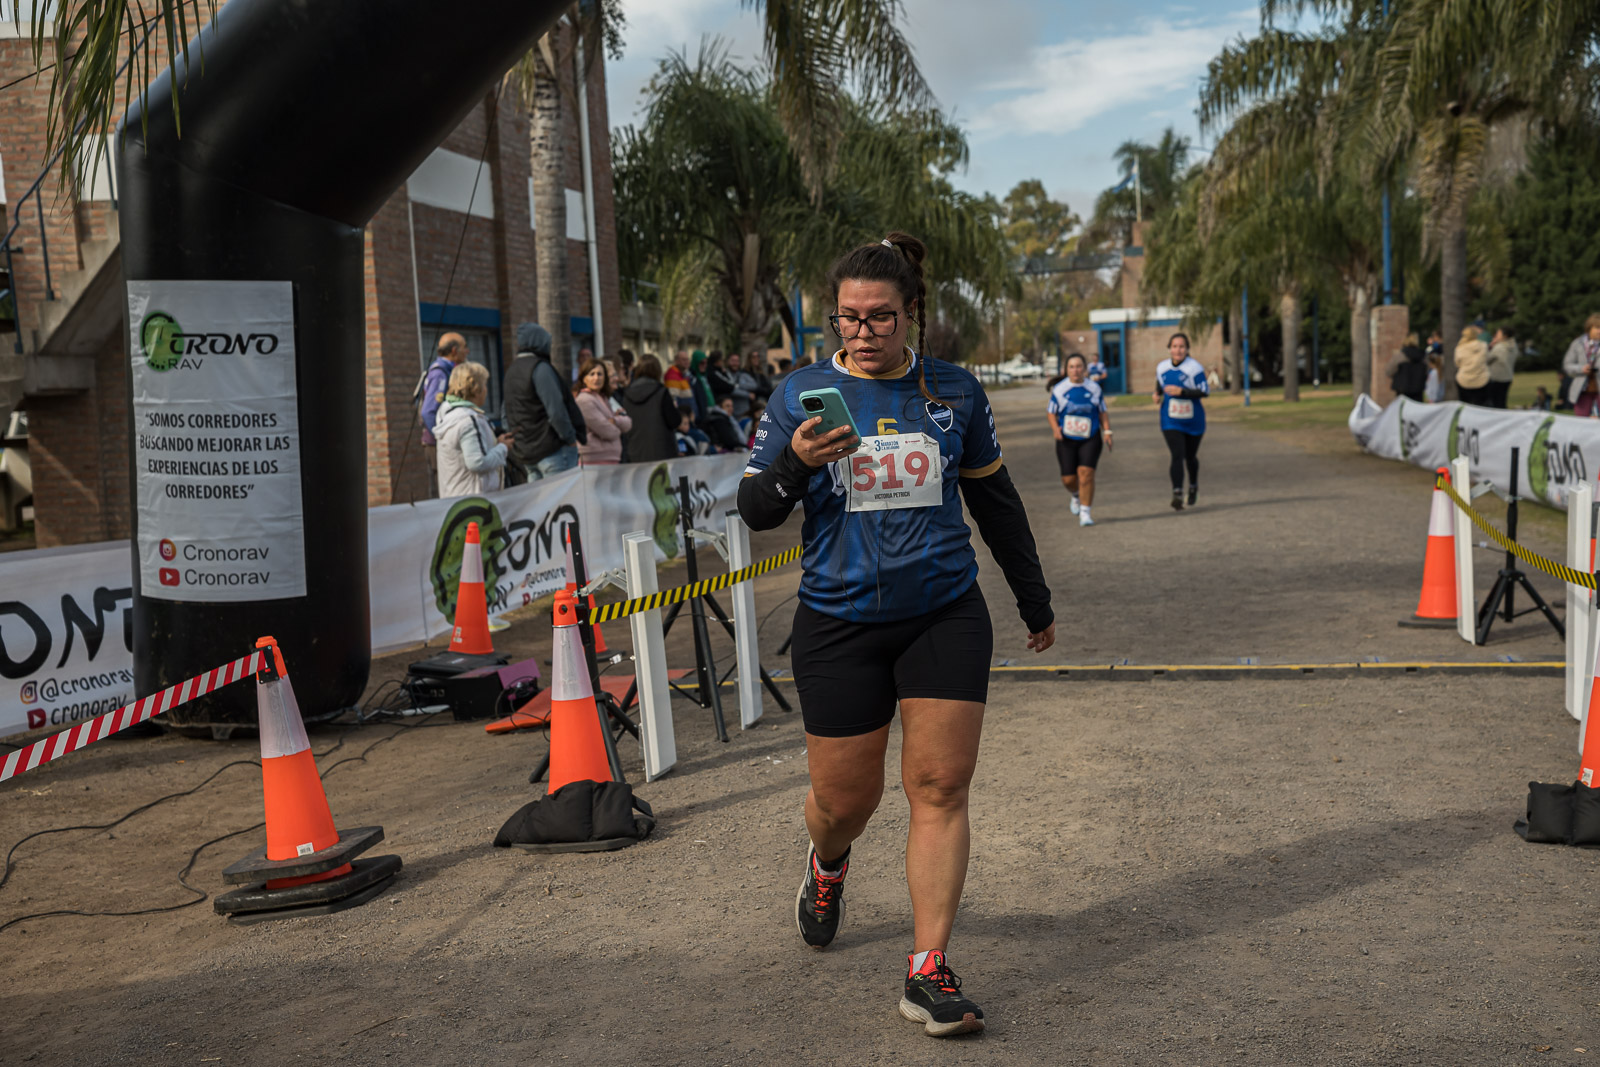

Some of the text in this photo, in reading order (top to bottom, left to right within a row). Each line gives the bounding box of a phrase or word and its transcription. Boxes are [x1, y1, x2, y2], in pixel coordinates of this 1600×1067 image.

[169, 332, 279, 356] CRONO
[168, 358, 203, 370] RAV
[188, 413, 277, 428] CORREDORES
[140, 434, 290, 452] BUSCANDO MEJORAR LAS
[148, 458, 279, 476] EXPERIENCIAS DE LOS
[852, 450, 930, 492] 519
[874, 492, 893, 500] VICTORIA
[183, 544, 269, 562] Cronorav
[184, 568, 270, 586] Cronorav
[51, 694, 127, 725] cronorav
